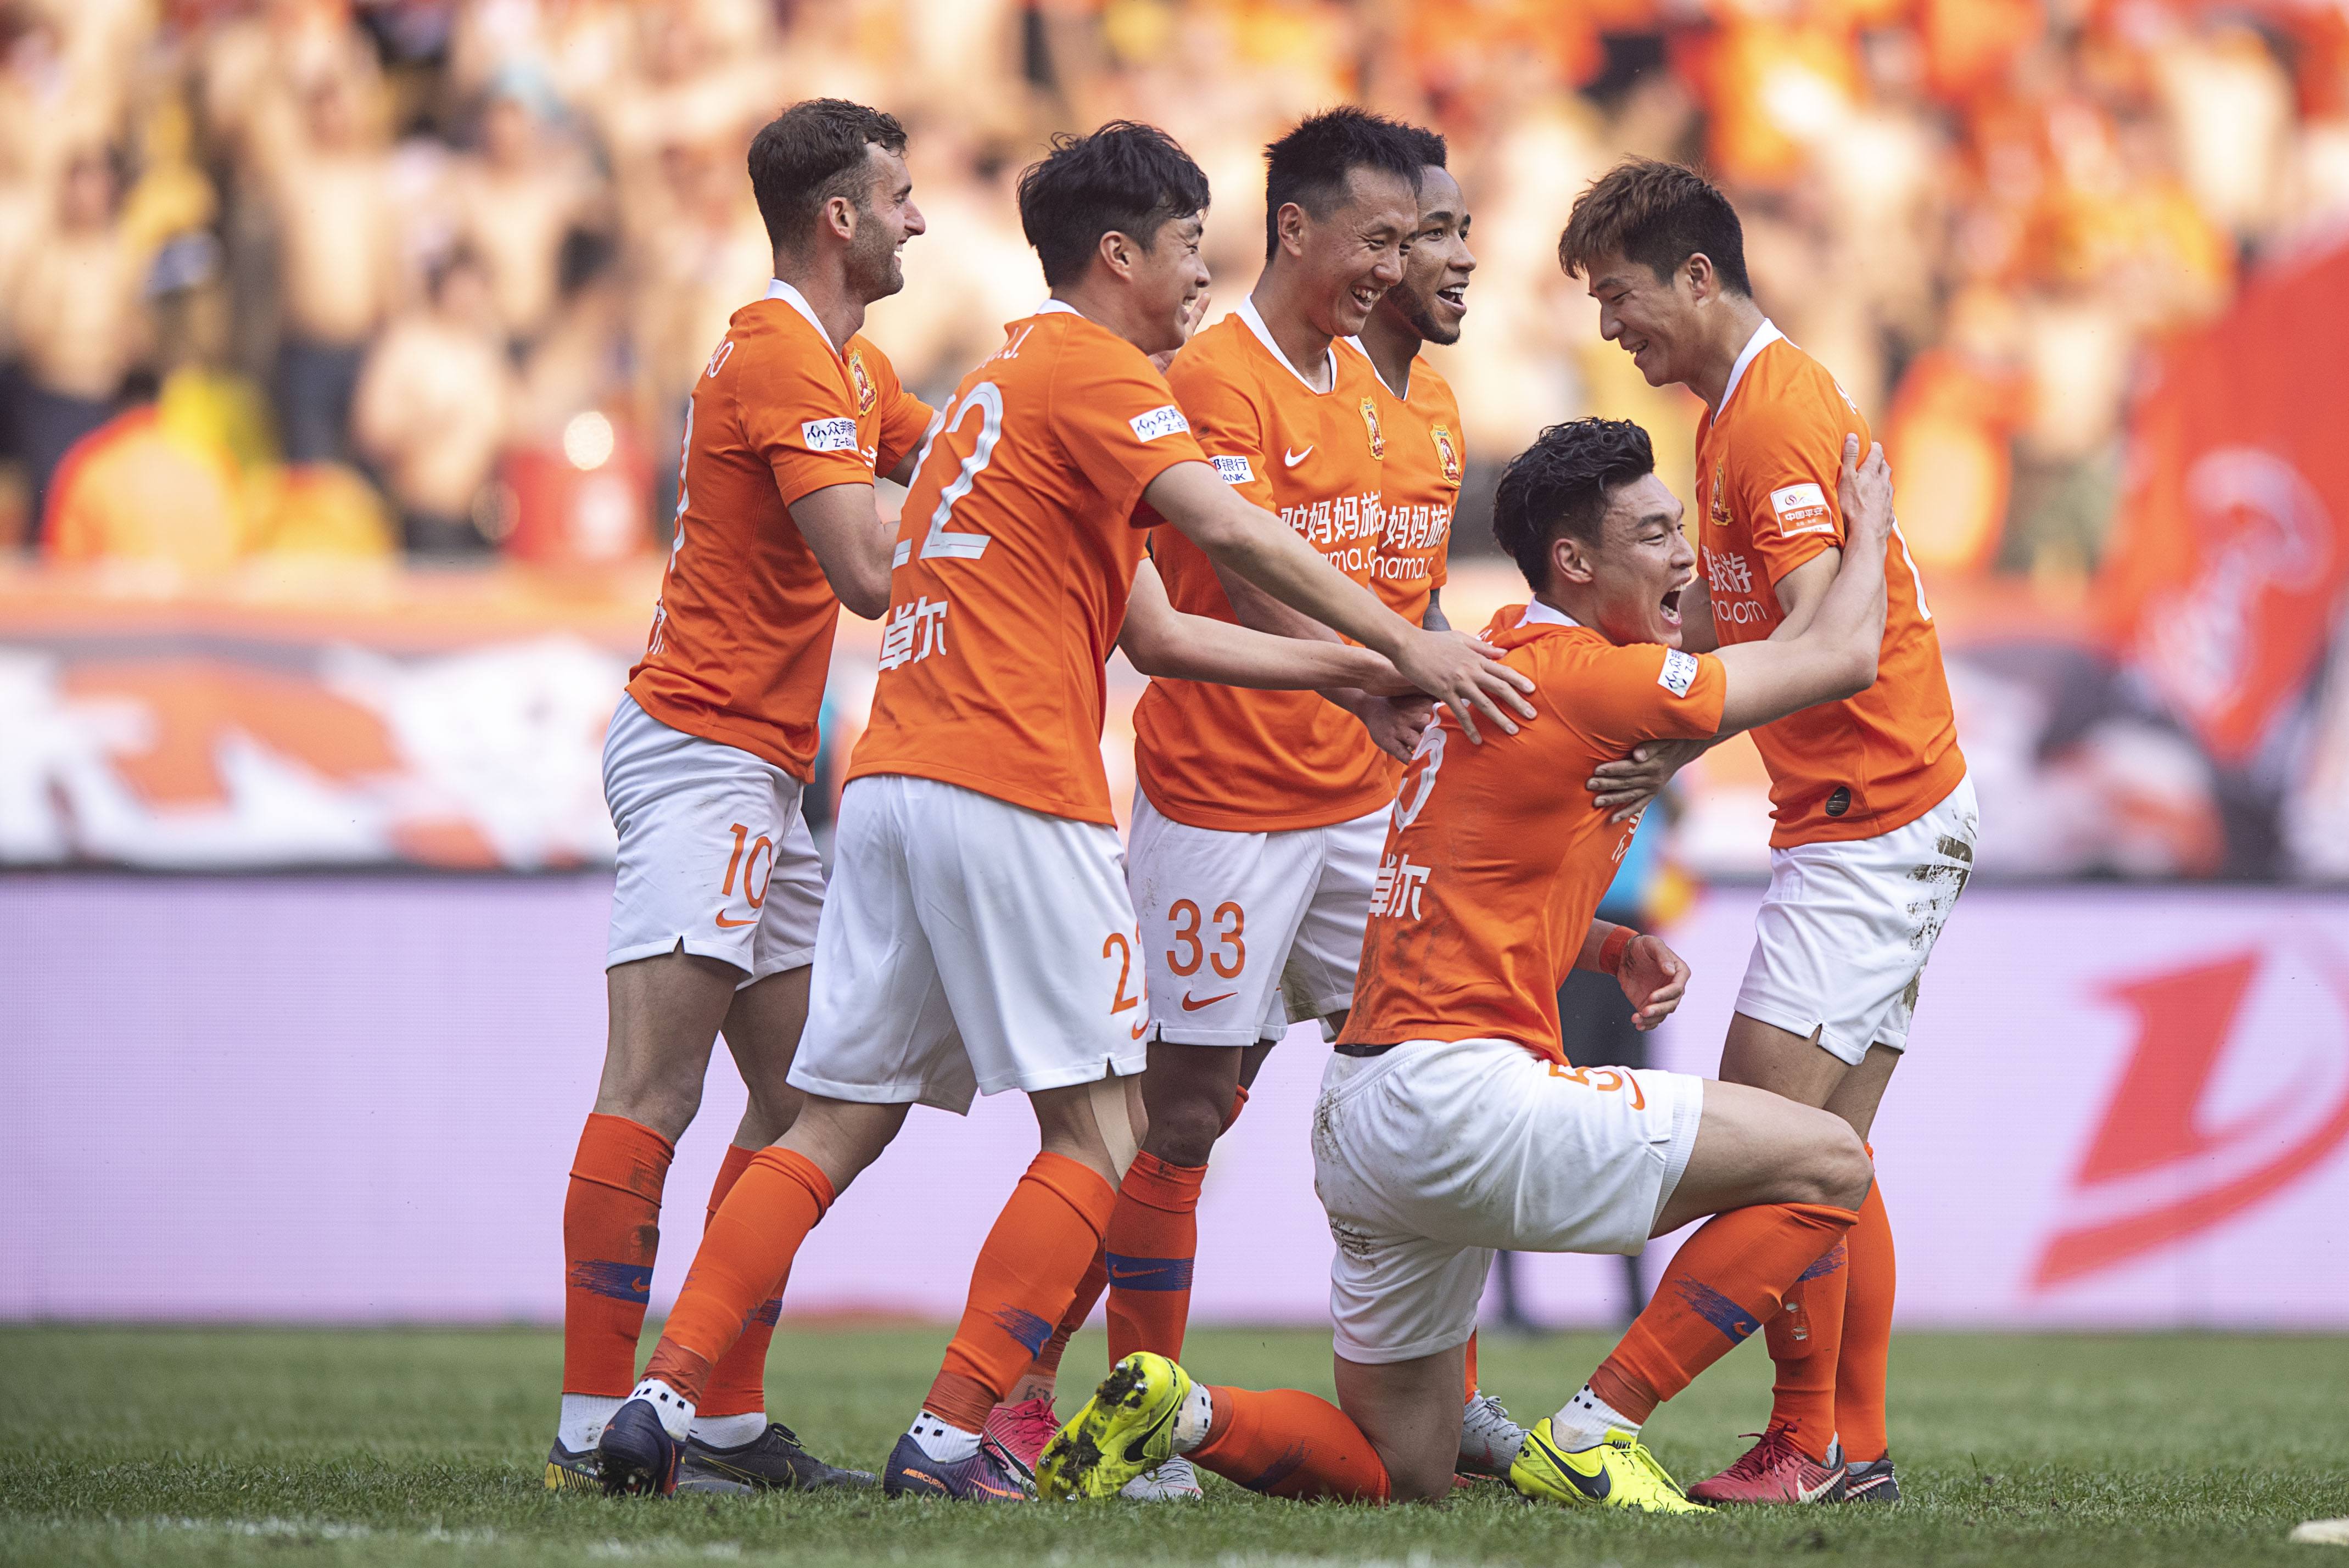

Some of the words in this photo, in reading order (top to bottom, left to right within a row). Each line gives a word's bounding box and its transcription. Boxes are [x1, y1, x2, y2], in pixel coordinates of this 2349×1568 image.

[879, 596, 948, 671] 卓尔
[722, 823, 773, 909] 10
[1368, 853, 1431, 921] 卓尔
[1103, 920, 1148, 1015] 2
[1166, 898, 1245, 979] 33
